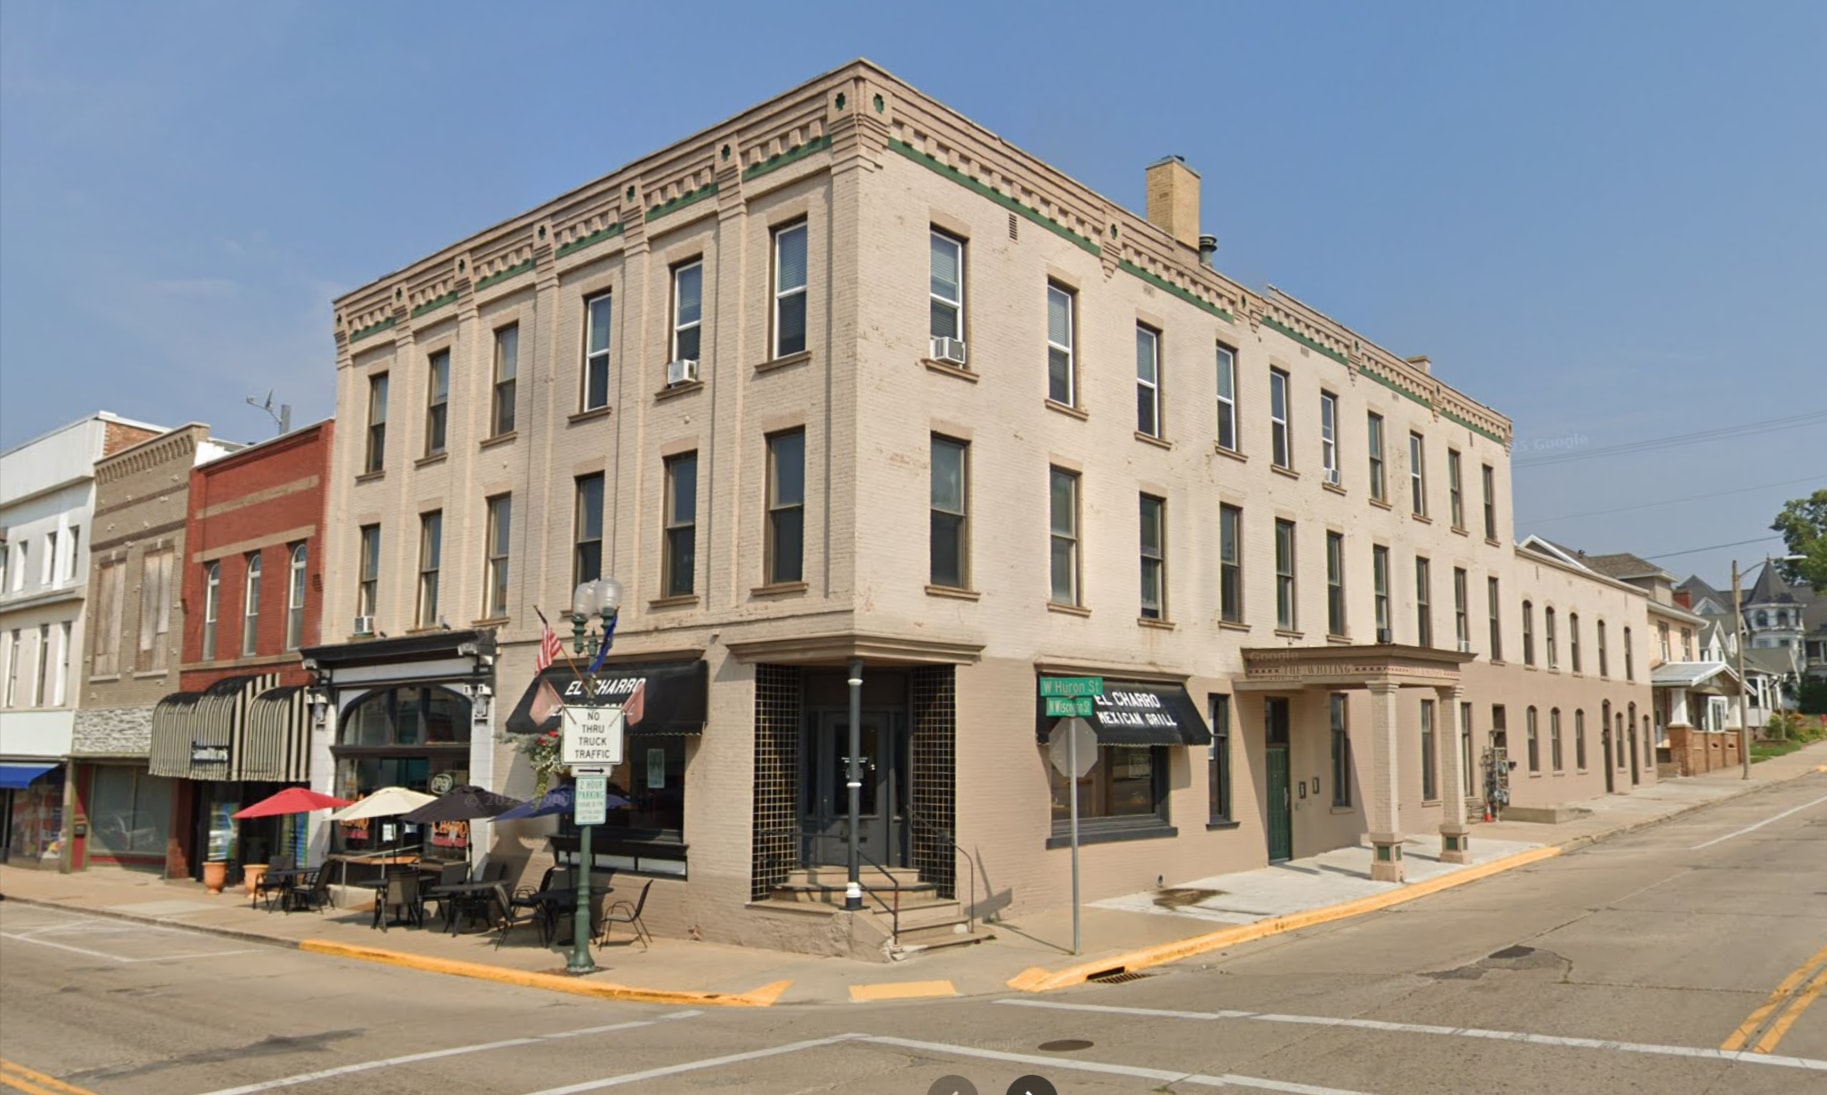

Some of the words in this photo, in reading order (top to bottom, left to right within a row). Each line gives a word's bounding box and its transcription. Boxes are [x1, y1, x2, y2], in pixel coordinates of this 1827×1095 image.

[1305, 663, 1353, 675] WHITING
[564, 680, 583, 696] EL
[1043, 680, 1052, 693] W
[1055, 680, 1085, 693] Huron
[1088, 680, 1099, 693] St
[1095, 694, 1113, 706] EL
[1112, 691, 1161, 708] CHARRO
[587, 712, 600, 721] NO
[1096, 711, 1144, 726] MEXICAN
[1146, 712, 1178, 727] GRILL
[582, 724, 605, 734] THRU
[578, 737, 607, 746] TRUCK
[575, 749, 610, 759] TRAFFIC
[586, 780, 603, 790] HOUR
[578, 790, 604, 800] PARKING
